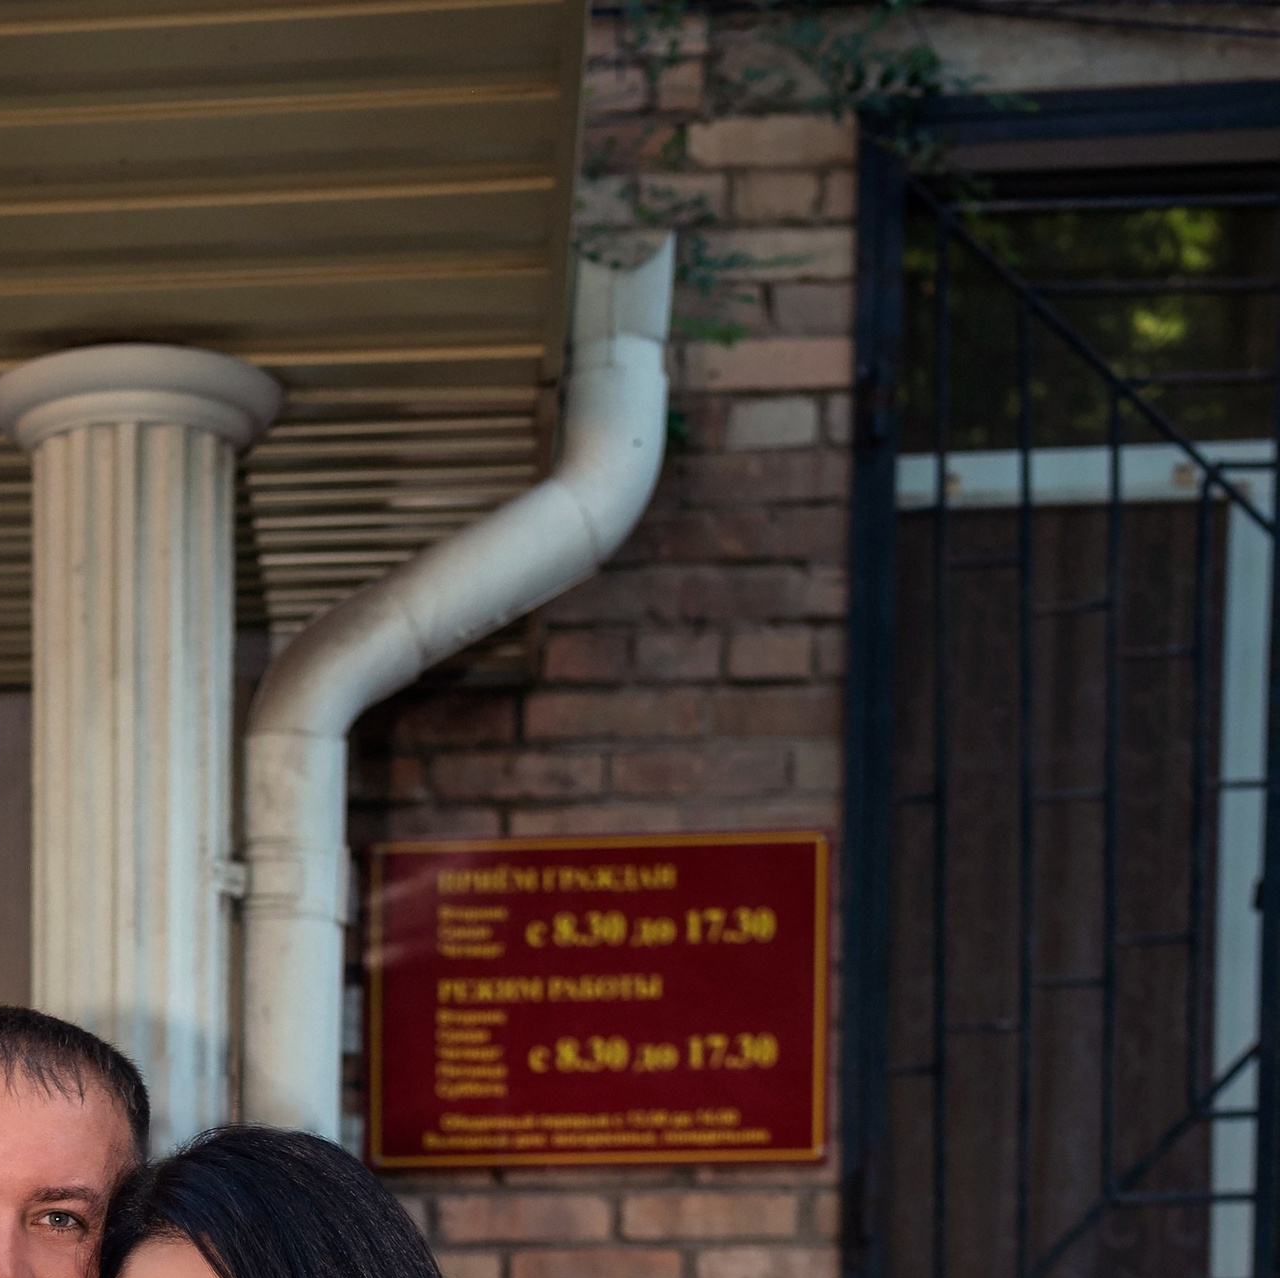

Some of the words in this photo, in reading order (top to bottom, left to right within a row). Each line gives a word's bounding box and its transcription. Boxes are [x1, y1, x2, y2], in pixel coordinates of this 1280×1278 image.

[553, 910, 627, 947] 8.30
[631, 916, 677, 947] до
[685, 906, 777, 945] 17.30
[555, 1035, 629, 1072] 8.30
[632, 1042, 680, 1074] до
[688, 1032, 779, 1071] 17.30
